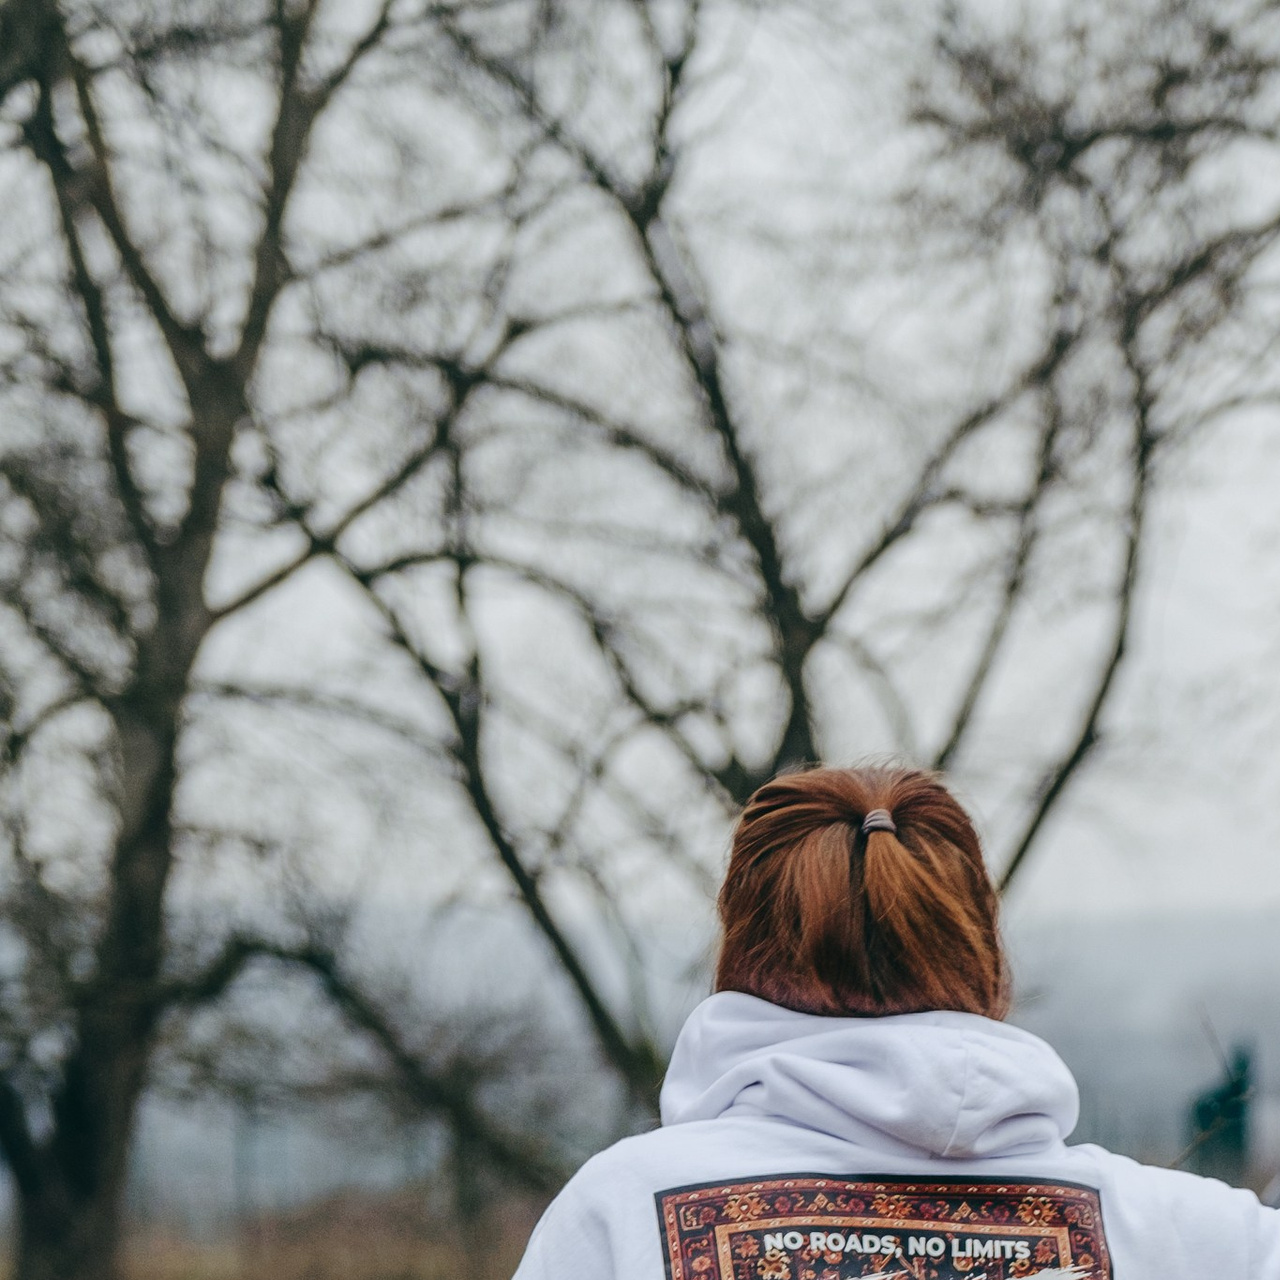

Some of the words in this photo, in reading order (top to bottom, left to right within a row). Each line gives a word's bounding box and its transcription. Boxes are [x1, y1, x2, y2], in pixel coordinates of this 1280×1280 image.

[763, 1231, 804, 1251] NO
[809, 1231, 902, 1258] ROADS,
[908, 1236, 945, 1258] NO
[951, 1238, 1031, 1260] LIMITS
